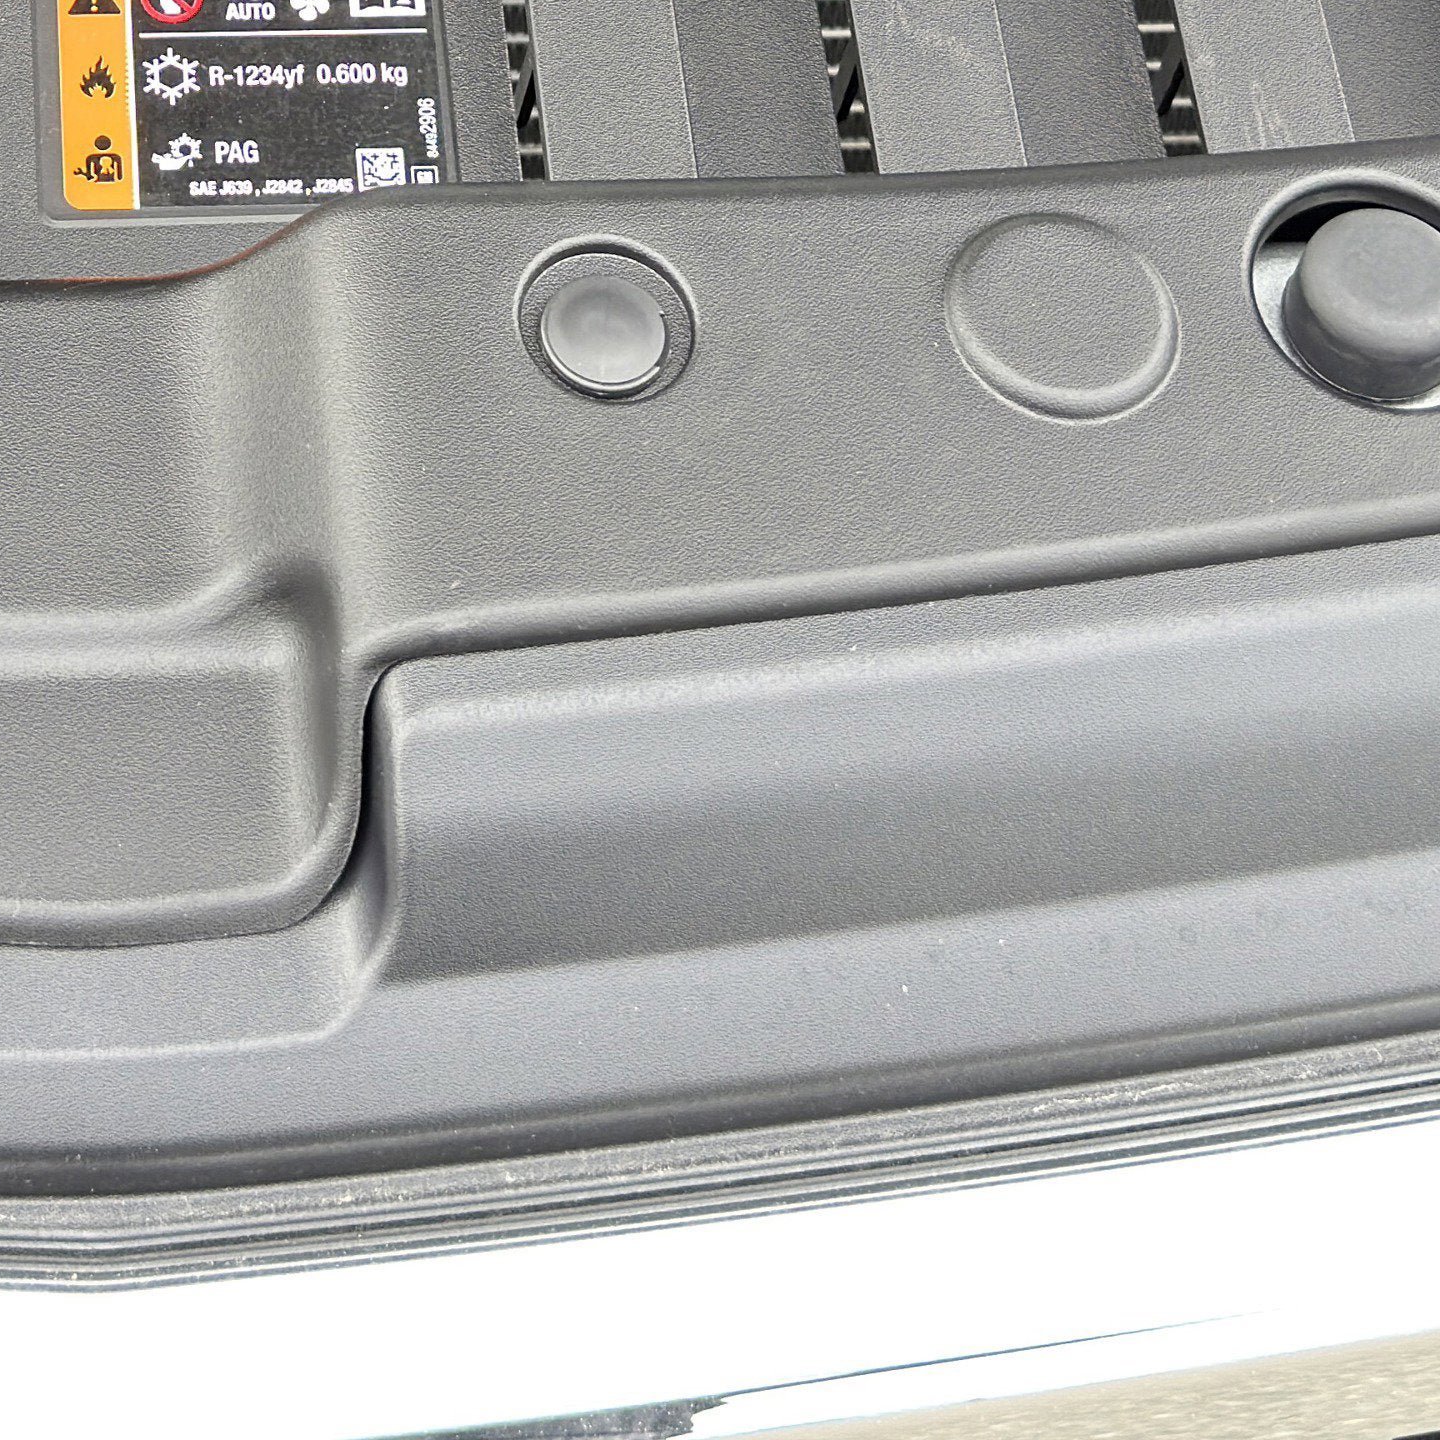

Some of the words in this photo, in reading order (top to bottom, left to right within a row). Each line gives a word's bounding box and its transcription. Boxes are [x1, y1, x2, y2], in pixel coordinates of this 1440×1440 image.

[225, 2, 276, 21] AUTO
[208, 64, 305, 89] R-1234yf
[316, 63, 377, 84] 0.600
[380, 62, 408, 86] kg
[214, 140, 260, 164] PAG
[189, 181, 218, 196] SAE
[312, 178, 354, 193] J2845
